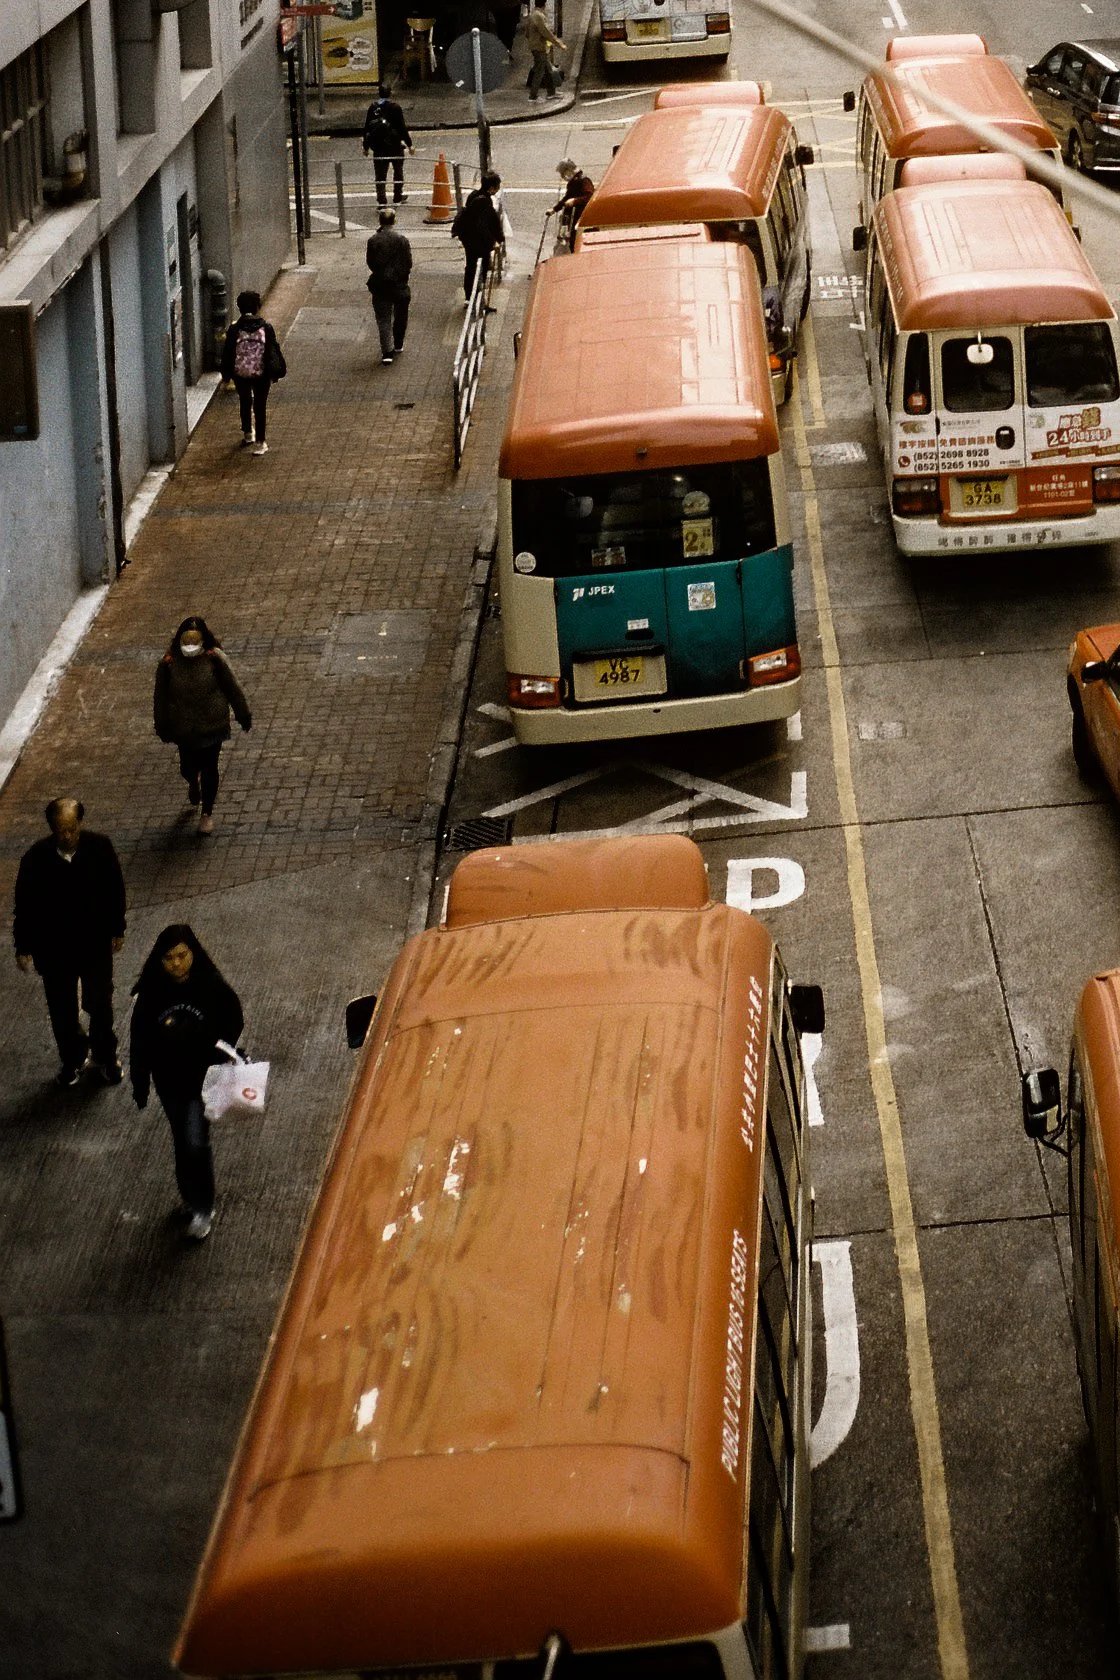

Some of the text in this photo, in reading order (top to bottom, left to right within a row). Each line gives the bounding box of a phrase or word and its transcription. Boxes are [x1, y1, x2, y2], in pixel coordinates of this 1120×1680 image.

[940, 450, 964, 459] 2698
[966, 448, 989, 457] 8928
[941, 461, 964, 470] 5265
[967, 460, 990, 468] 1930
[973, 483, 993, 494] GA
[964, 494, 1001, 506] 3738
[588, 585, 615, 596] JPEX
[609, 658, 629, 671] VC
[599, 670, 641, 684] 4987
[721, 1228, 748, 1485] PUBLIC LIGHT BUS 16 SEATS
